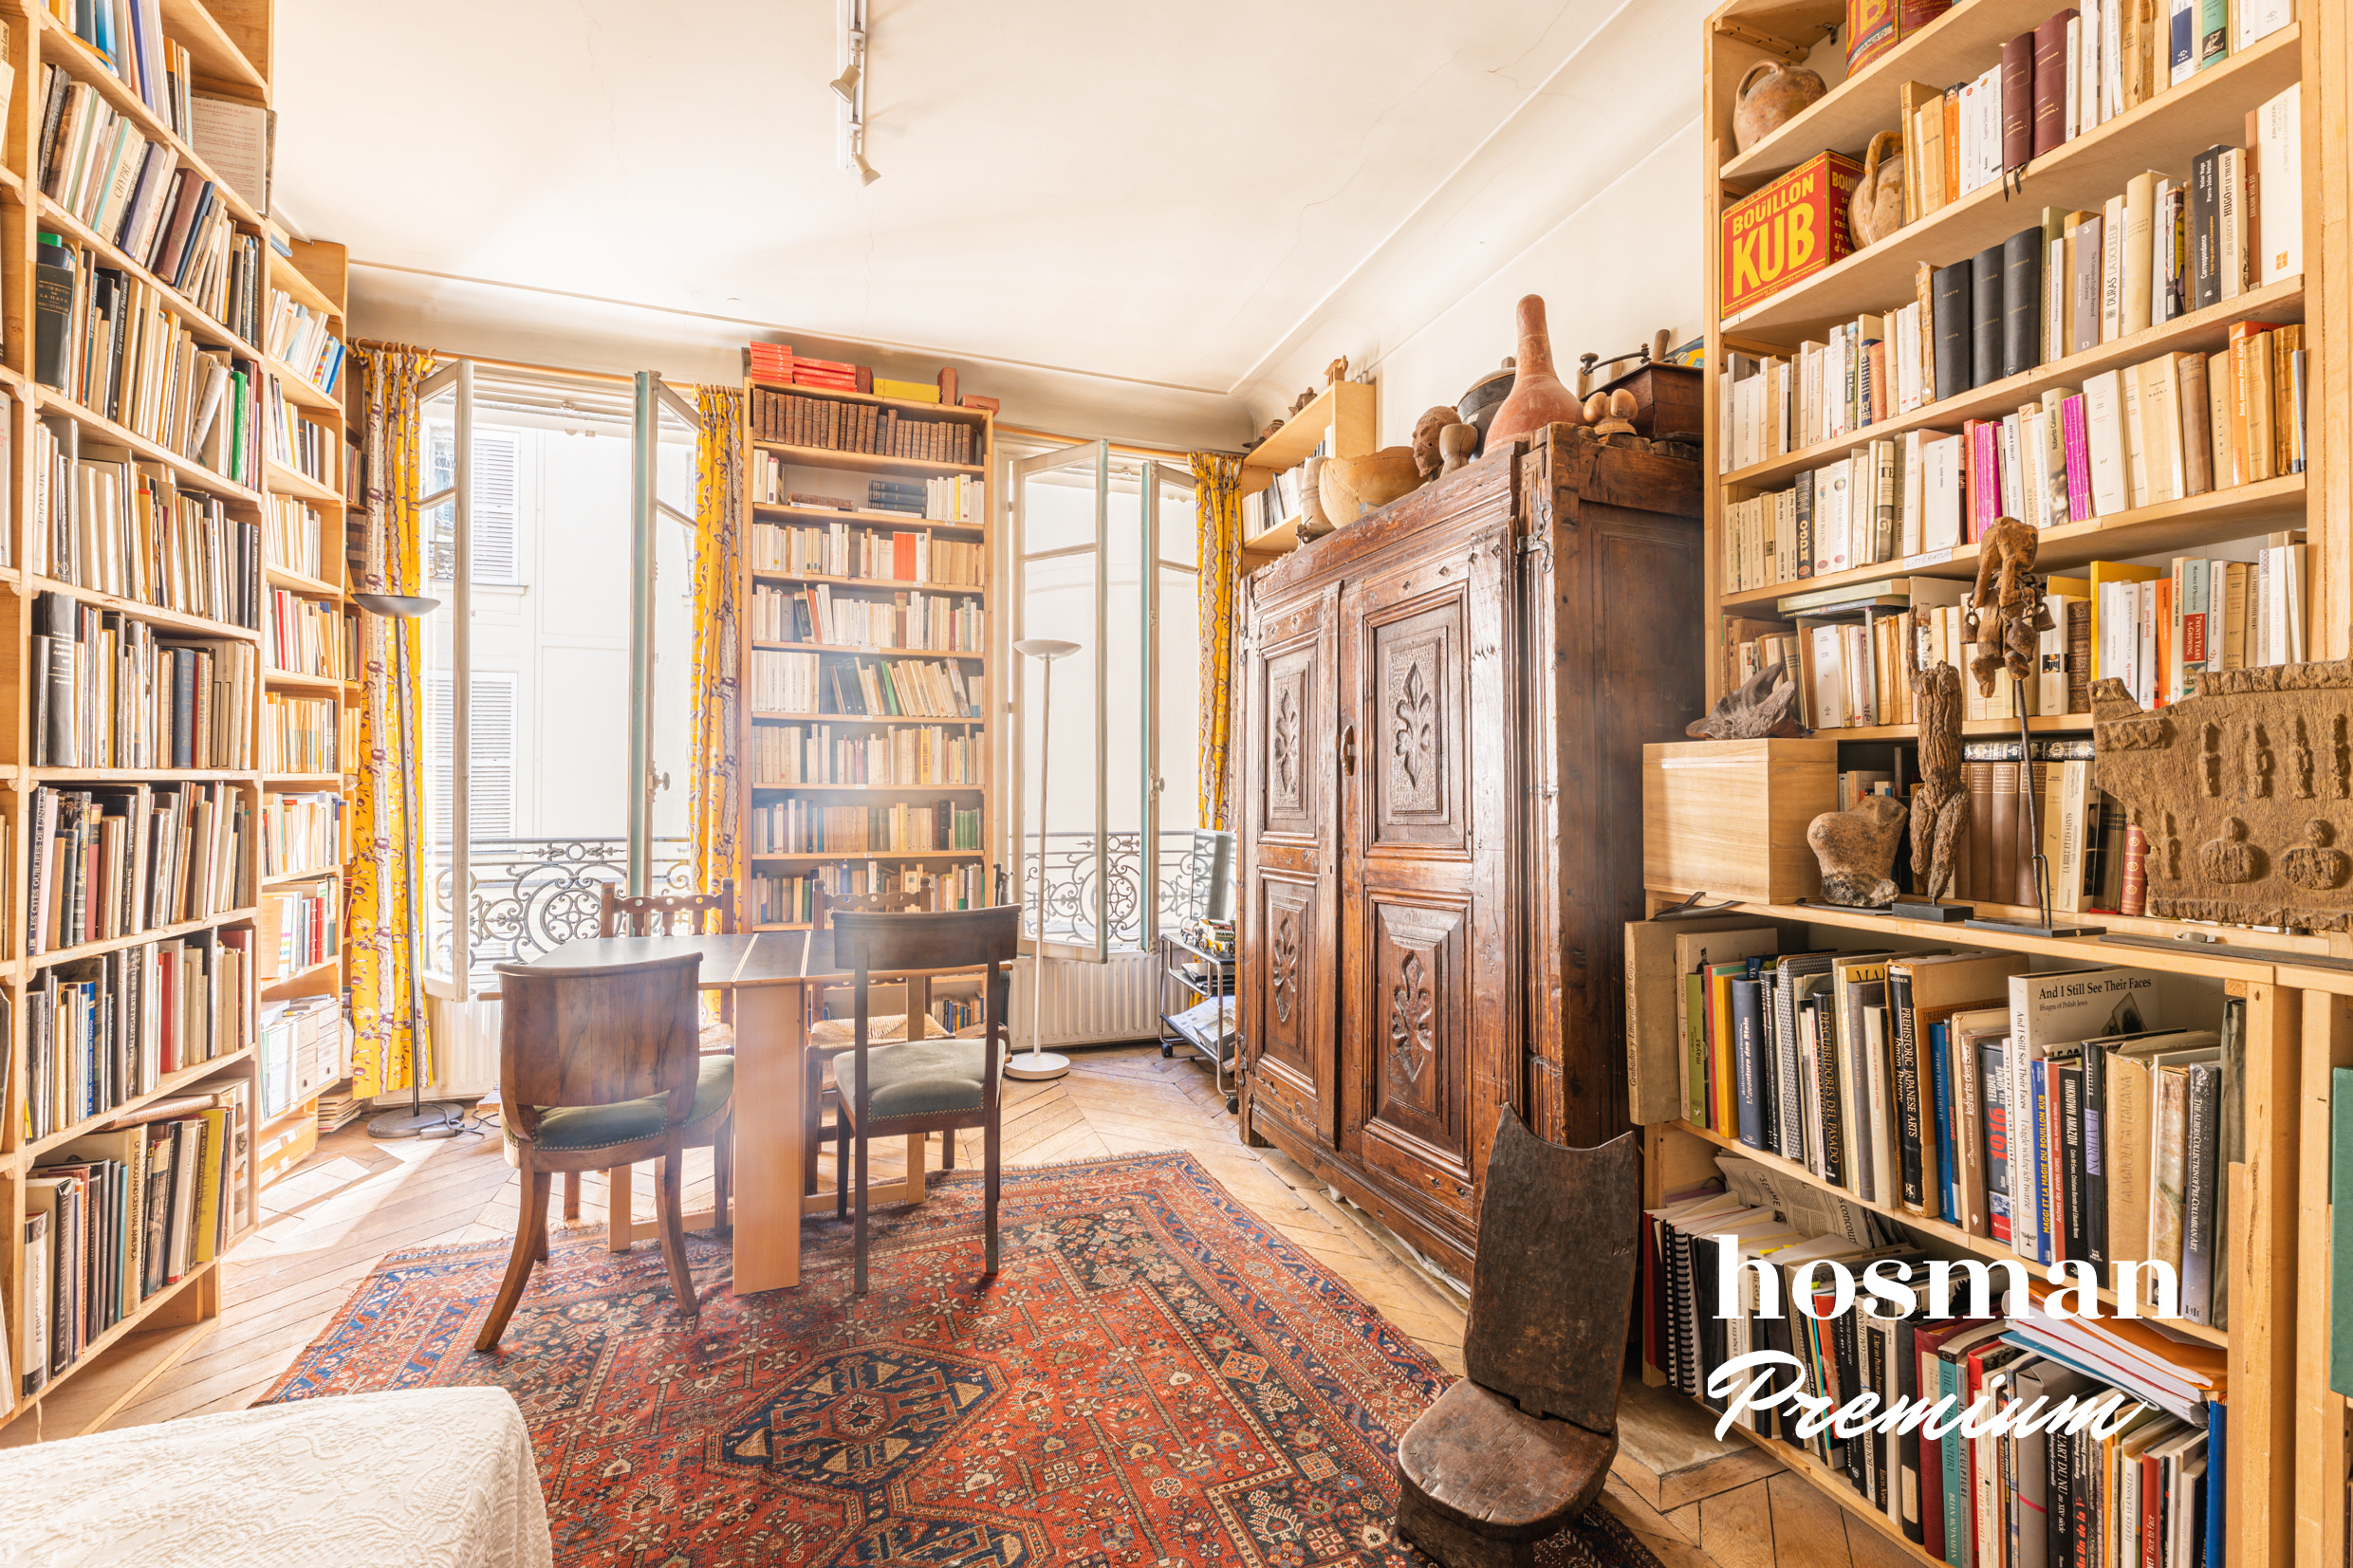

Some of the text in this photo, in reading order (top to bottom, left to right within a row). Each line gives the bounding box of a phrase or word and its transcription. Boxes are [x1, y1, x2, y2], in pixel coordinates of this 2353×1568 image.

[114, 161, 131, 199] CHYPRE
[1732, 172, 1814, 237] BOUILLON
[1732, 202, 1815, 299] KUB
[2200, 234, 2209, 279] Correspondance
[2106, 222, 2119, 307] DURAS LA DOULEUR
[1799, 520, 1809, 563] HUGO
[2065, 812, 2073, 832] SAINTS
[2063, 849, 2071, 866] BIBLE
[2038, 987, 2059, 1000] And
[2066, 982, 2085, 997] Still
[2087, 982, 2103, 994] See
[2104, 979, 2127, 992] Their
[2129, 976, 2152, 991] Faces
[2063, 1001, 2077, 1010] Polish
[2077, 999, 2088, 1008] Jews
[1742, 1016, 1751, 1040] Stein
[1744, 1059, 1754, 1104] L'aventure
[1901, 1007, 1918, 1138] PREHISTORIC JAPANESE ARTS
[1820, 1011, 1840, 1164] DESCUBRIDORES DEL PASADO
[1986, 1073, 1998, 1102] VERDUN
[2065, 1079, 2078, 1146] UNKNOWN AMAZON
[1988, 1107, 2010, 1161] 1916
[2038, 1111, 2047, 1149] BOUILLON
[133, 1140, 140, 1151] OF
[2040, 1150, 2047, 1161] DU
[132, 1151, 140, 1179] MEXICO
[2040, 1162, 2048, 1187] MAGIE
[2041, 1187, 2048, 1197] LA
[2041, 1197, 2048, 1208] ET
[2042, 1208, 2050, 1233] MAGGI
[2054, 1202, 2063, 1223] Archives
[1858, 1309, 1866, 1353] GAUTRAND
[1943, 1370, 1955, 1388] THE
[2056, 1456, 2067, 1473] DU
[2058, 1474, 2068, 1495] NU
[1947, 1492, 1958, 1559] BRIAN MOYNAHAN
[2145, 1514, 2155, 1531] Face
[2146, 1540, 2156, 1555] Face
